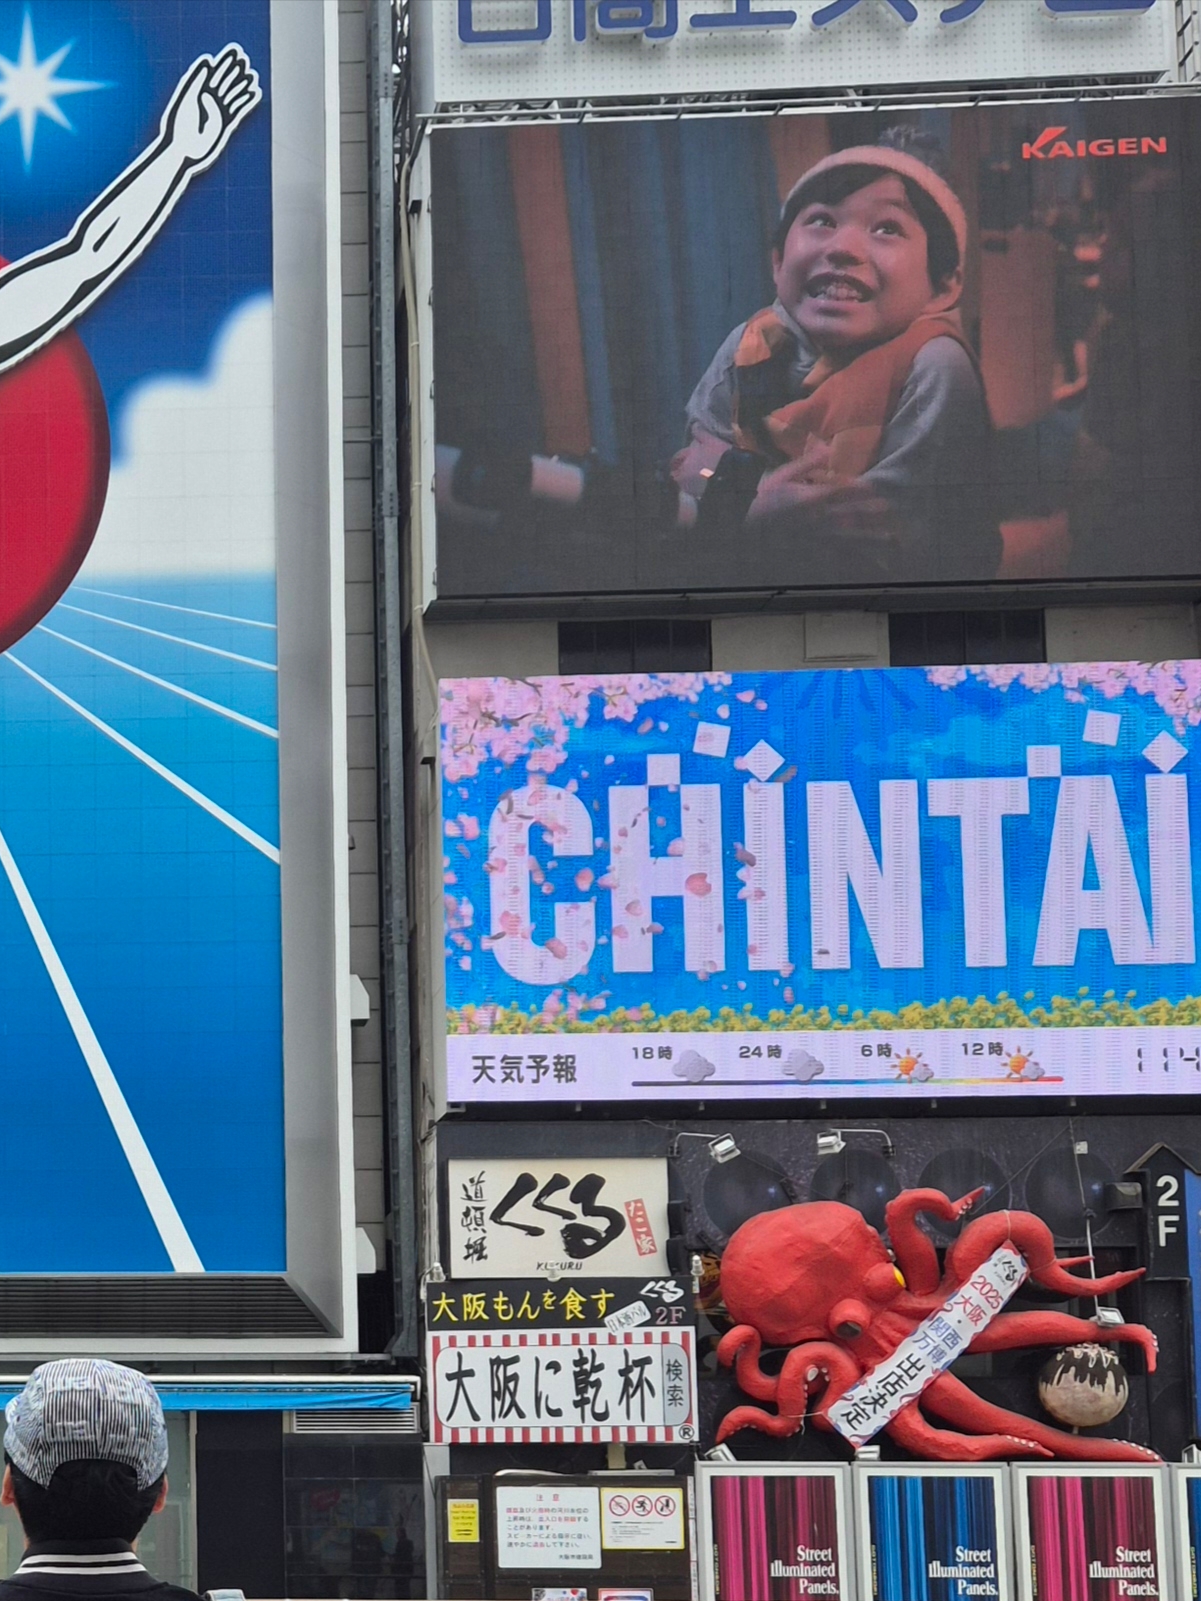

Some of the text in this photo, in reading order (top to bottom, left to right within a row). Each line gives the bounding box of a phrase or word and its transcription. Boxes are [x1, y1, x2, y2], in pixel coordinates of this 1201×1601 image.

[1022, 125, 1167, 158] KAIGEN
[488, 742, 1196, 985] CHINTAI
[631, 1041, 1003, 1060] 18時 24時 6時 12時
[472, 1053, 578, 1084] 天気予報
[460, 1170, 489, 1263] 道頓堀
[490, 1172, 626, 1259] くくる
[1156, 1174, 1180, 1247] 2F
[432, 1287, 615, 1321] 大阪もんを食す
[639, 1280, 685, 1303] くくる
[970, 1275, 1004, 1310] 2025
[655, 1306, 686, 1325] 2F
[913, 1331, 948, 1365] 万博
[928, 1316, 963, 1351] 関西
[445, 1348, 684, 1424] 大阪に乾杯 検索
[797, 1545, 832, 1562] Street
[955, 1546, 992, 1562] Street
[1115, 1546, 1152, 1562] Street
[799, 1578, 840, 1595] Panels.
[957, 1579, 998, 1596] Panels.
[1118, 1579, 1159, 1596] Panels.
